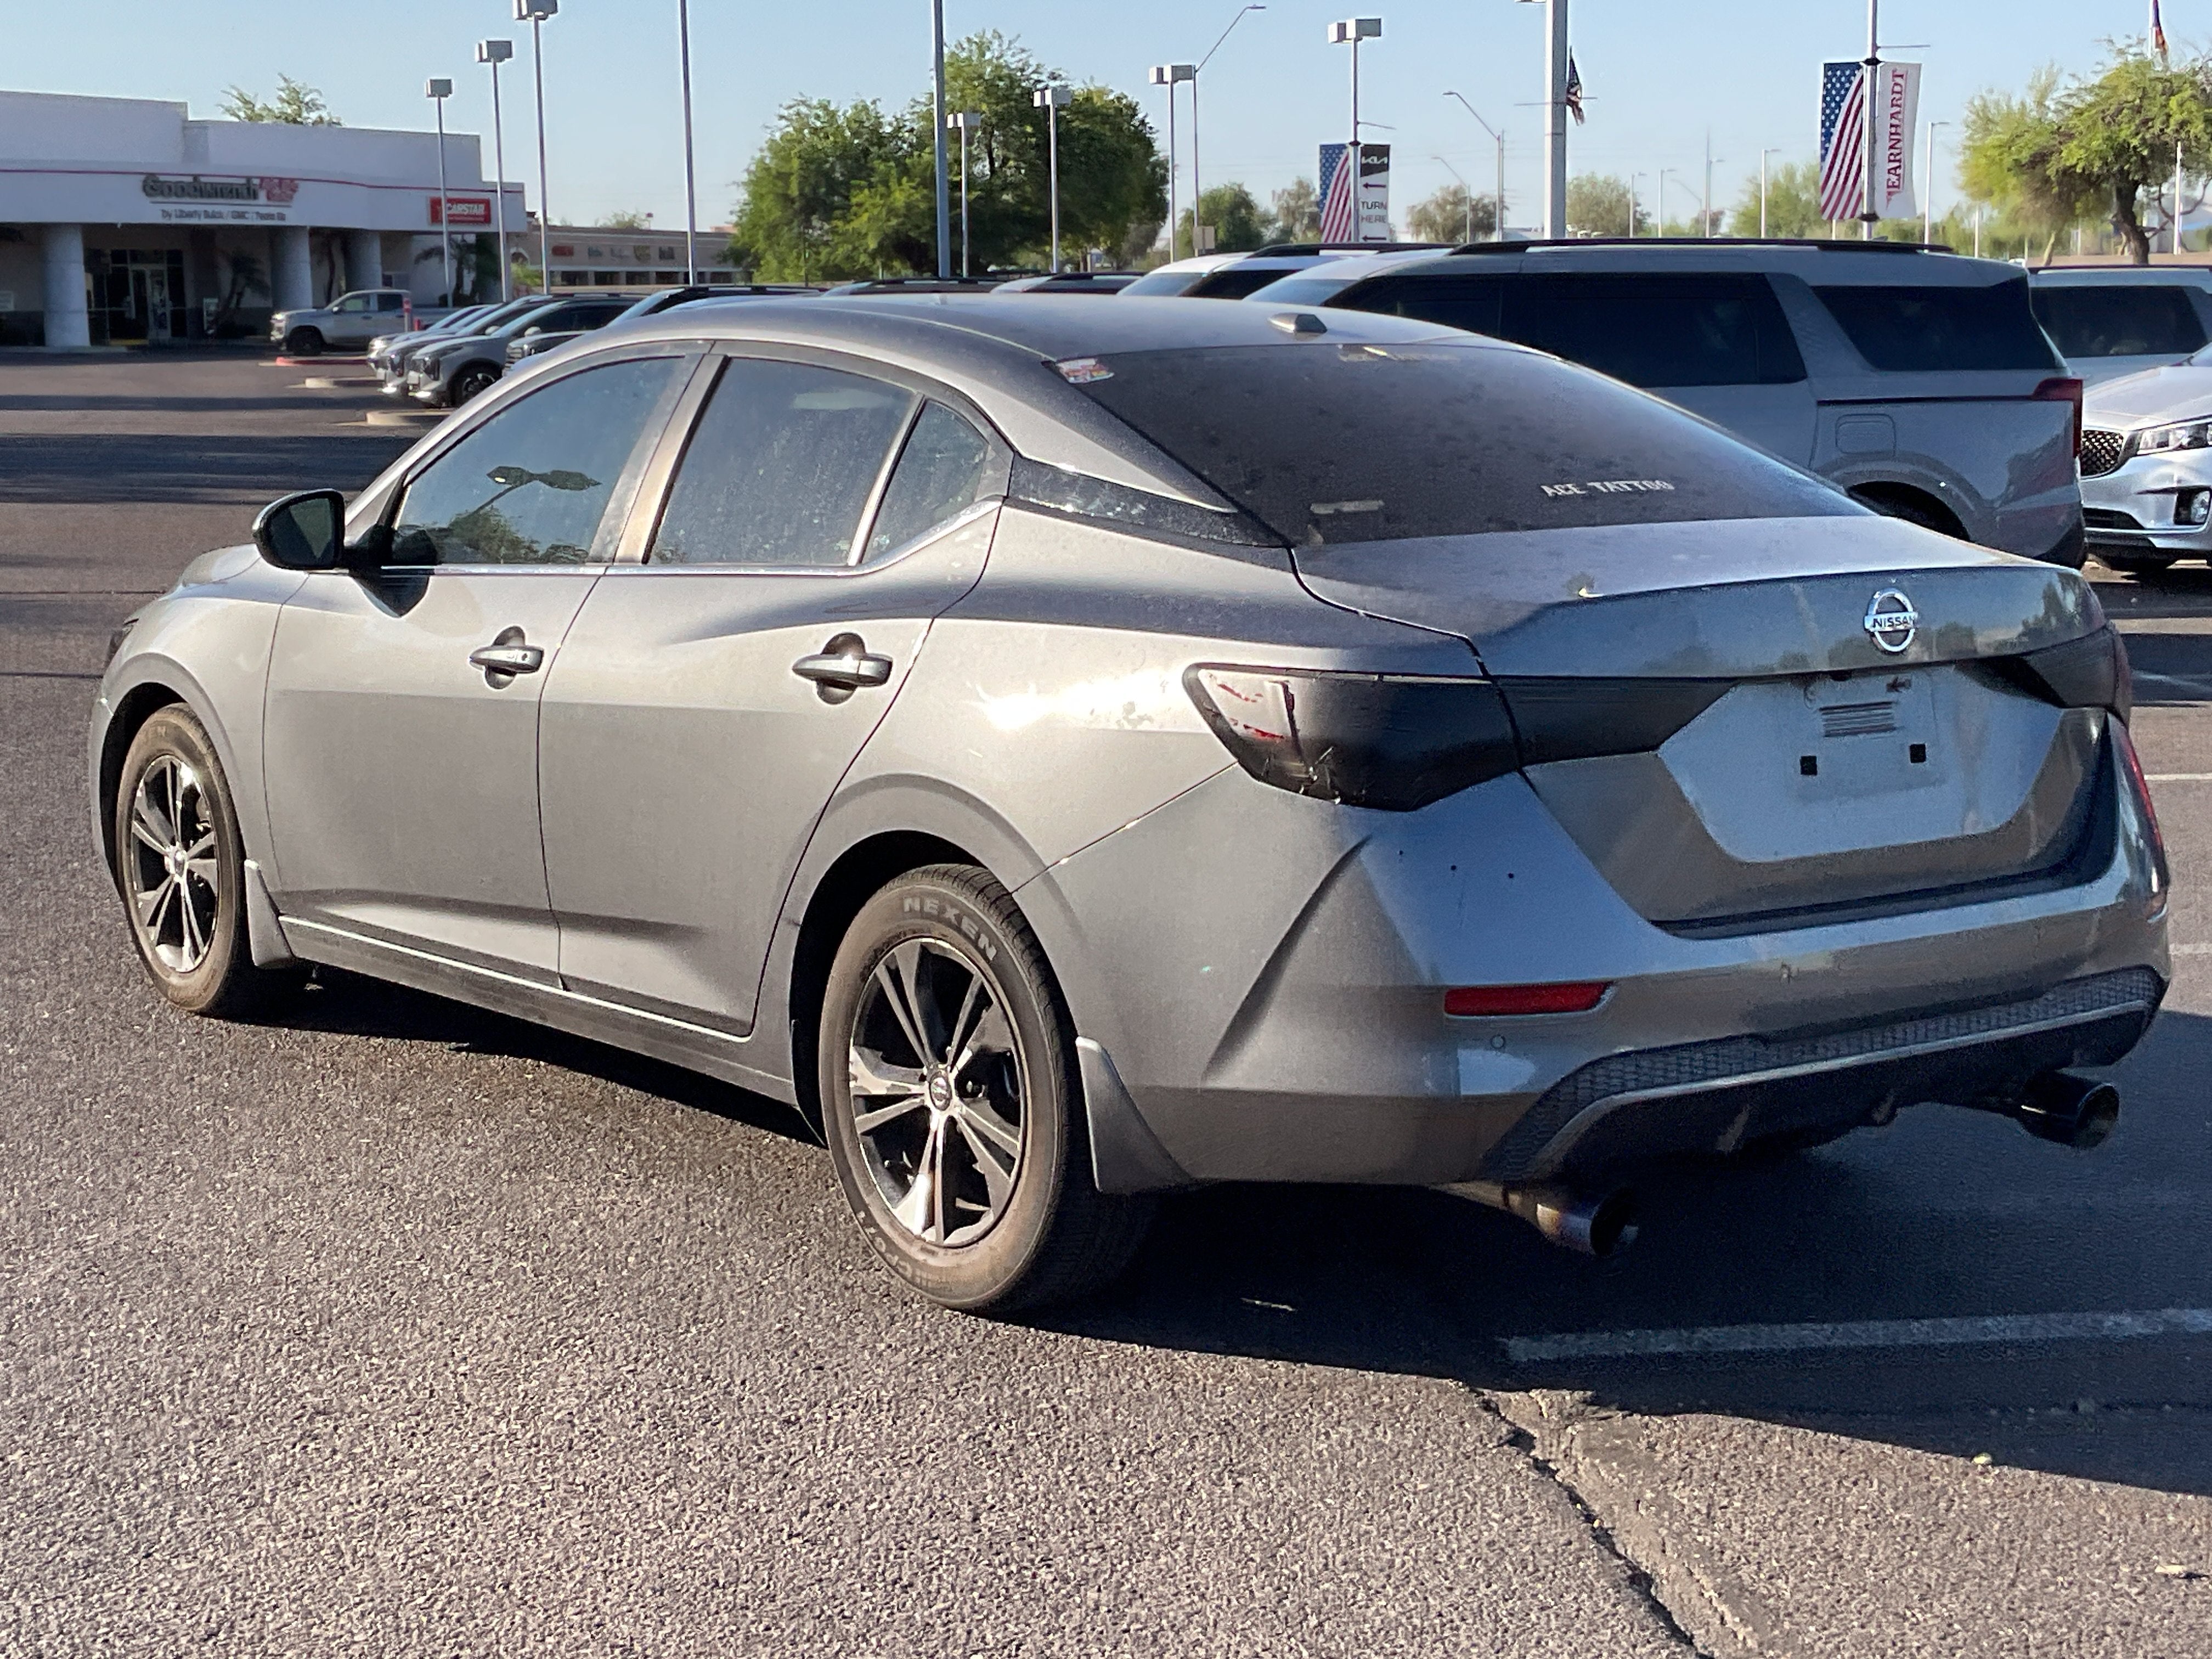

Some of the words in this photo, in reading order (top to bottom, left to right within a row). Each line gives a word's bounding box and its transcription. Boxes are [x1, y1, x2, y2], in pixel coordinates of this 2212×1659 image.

[1886, 68, 1905, 190] EARNHARDT
[1361, 201, 1387, 210] TURN
[1361, 215, 1386, 223] HERE
[1541, 483, 1587, 496] ACE
[1872, 615, 1915, 628] NISSAN
[904, 896, 997, 961] NEXEN
